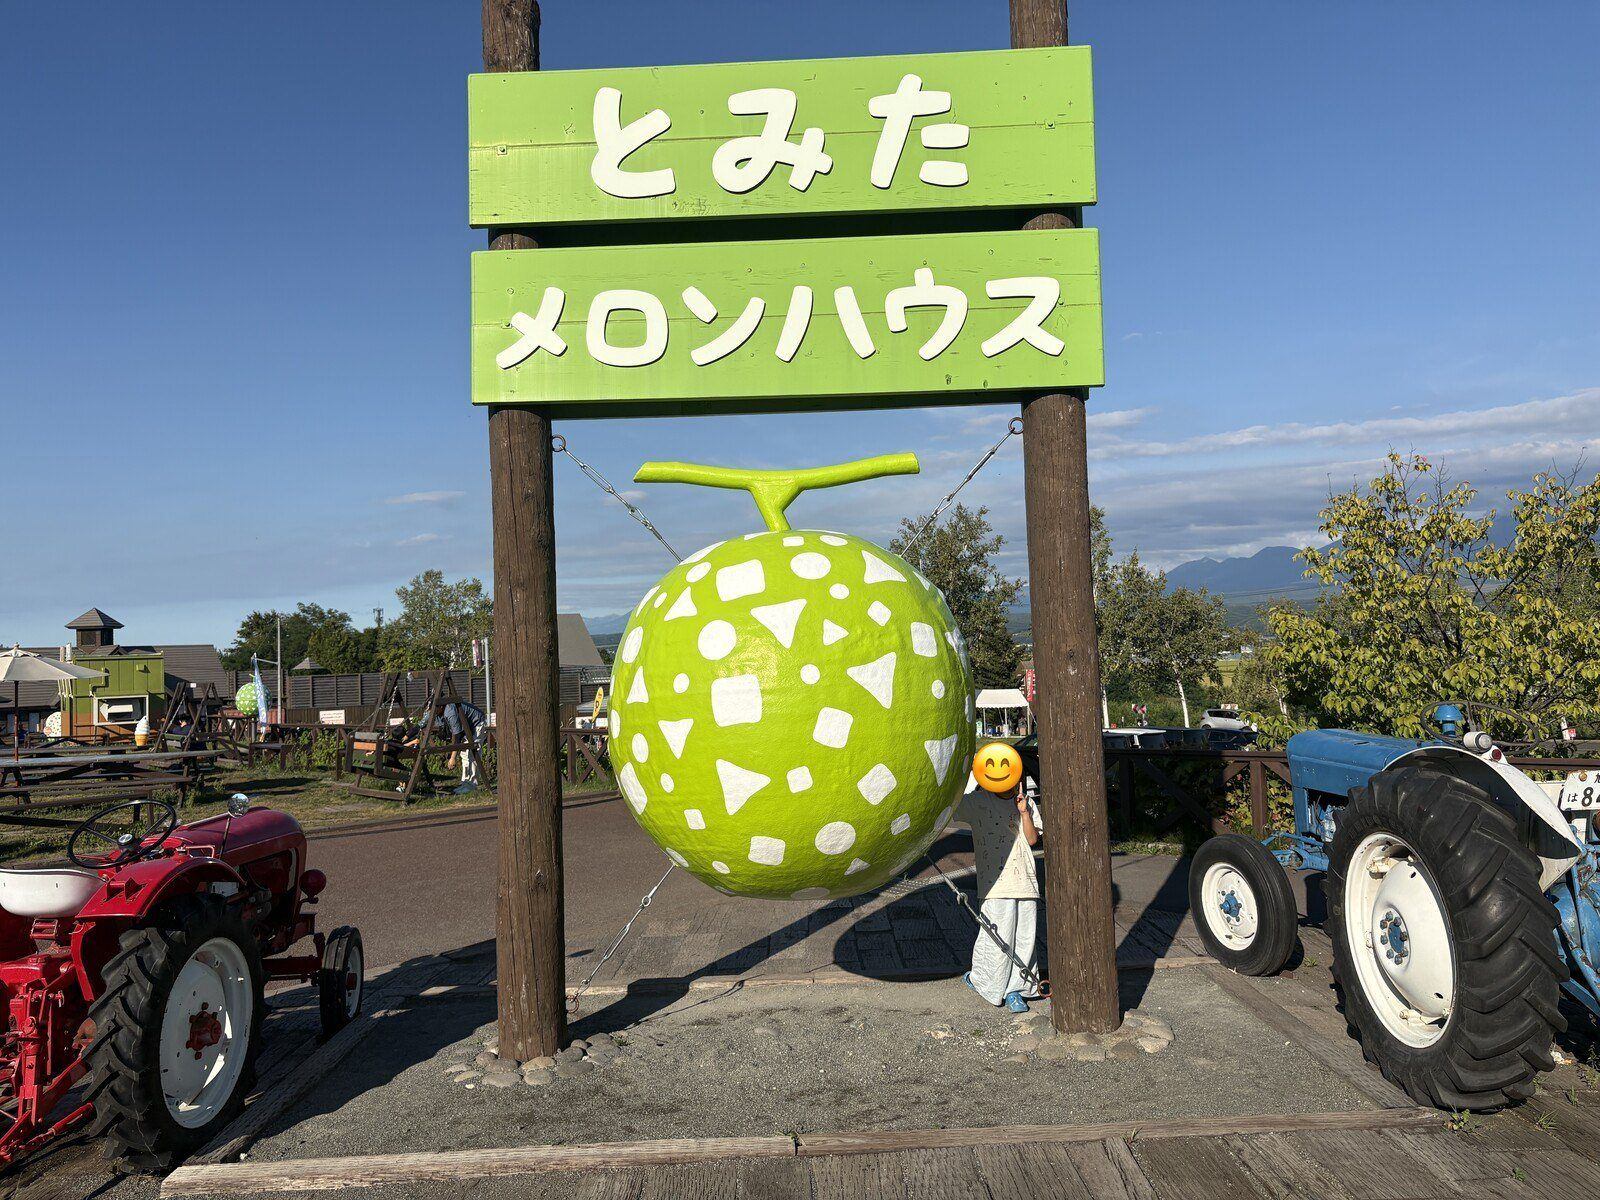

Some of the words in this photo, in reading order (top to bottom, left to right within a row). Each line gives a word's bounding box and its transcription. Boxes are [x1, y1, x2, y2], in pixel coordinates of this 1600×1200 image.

[591, 74, 969, 197] とみた
[496, 268, 1065, 369] メロンハウス
[1567, 793, 1578, 803] は
